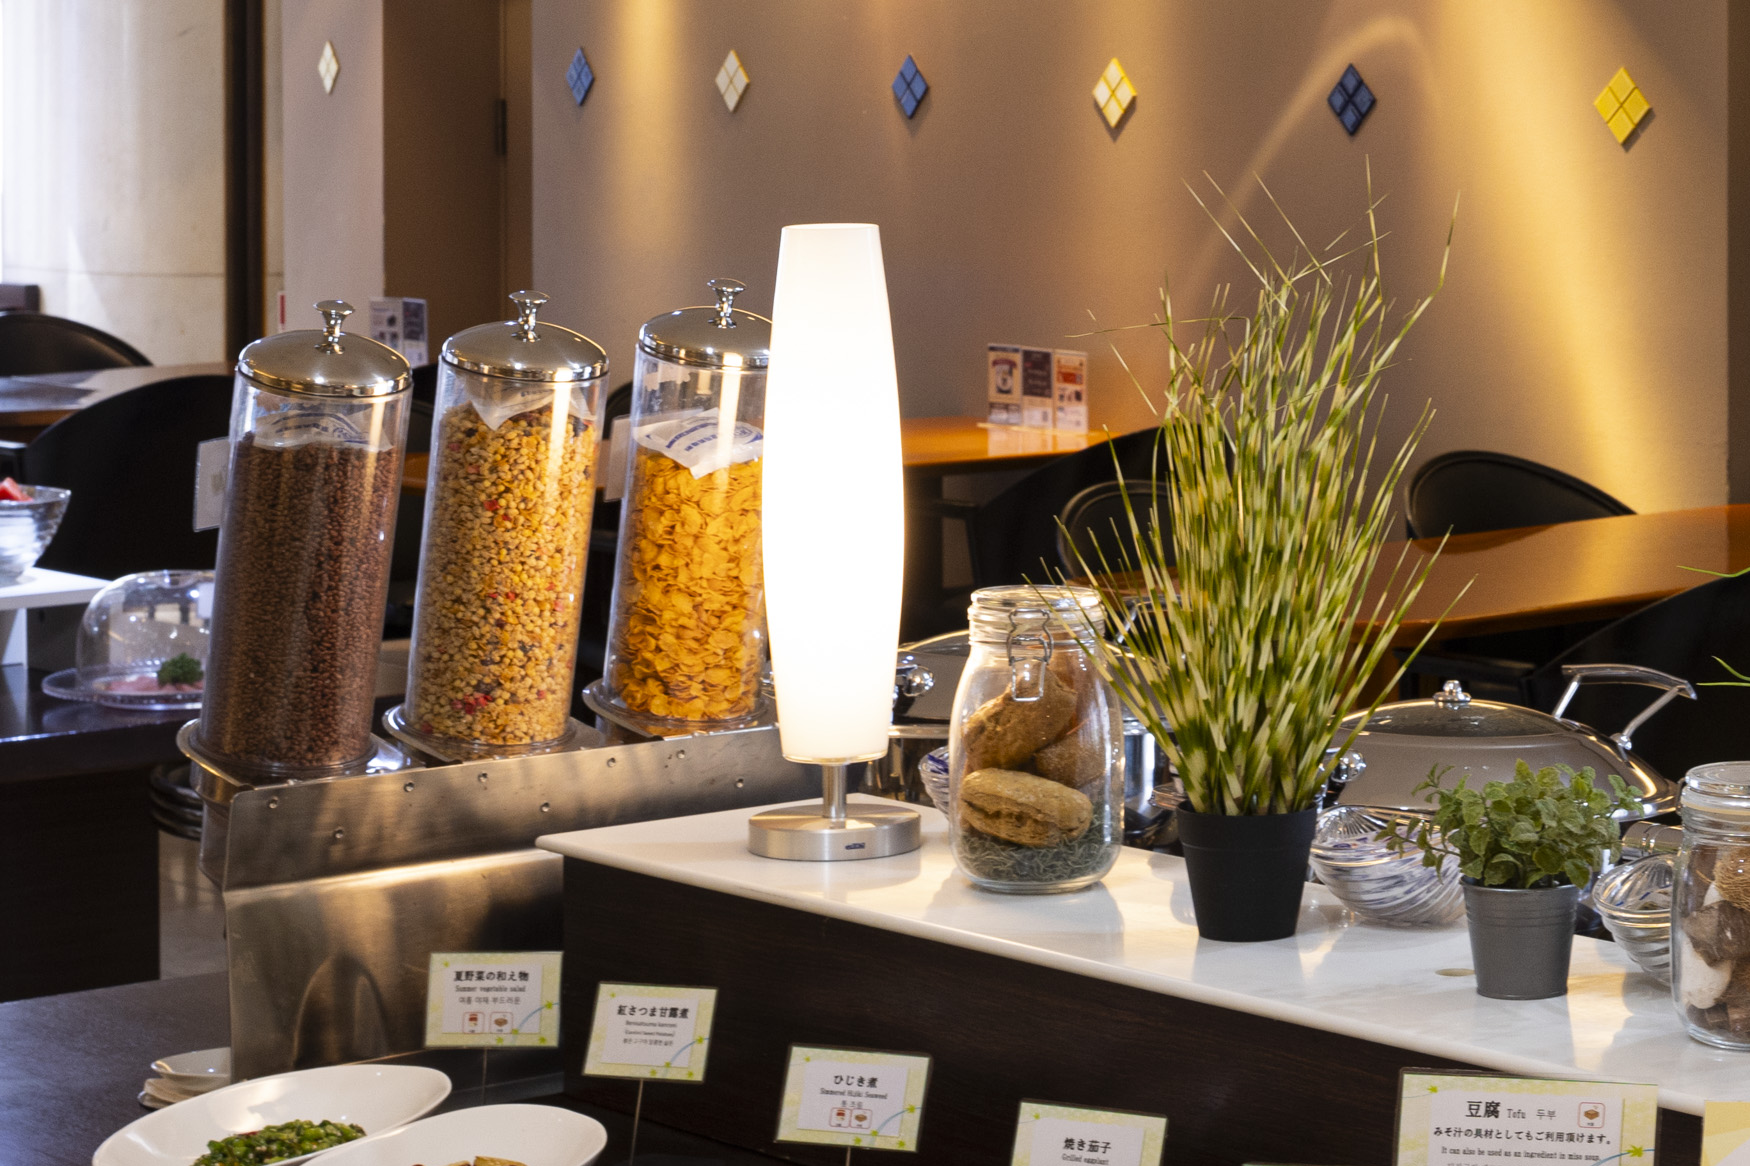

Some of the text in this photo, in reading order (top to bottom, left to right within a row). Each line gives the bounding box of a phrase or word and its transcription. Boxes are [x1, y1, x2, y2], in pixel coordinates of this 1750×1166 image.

[454, 971, 529, 981] 夏野菜の和え物
[617, 1005, 689, 1019] 紅さつま甘露煮
[833, 1074, 878, 1088] ひじき煮
[1466, 1100, 1557, 1121] 豆腐 Tofu 두부
[1433, 1126, 1612, 1145] みそ汁の具材としてもご利用頂けます。
[1063, 1137, 1111, 1154] 焼き茄子
[1441, 1146, 1448, 1154] It
[1462, 1147, 1475, 1156] also
[1478, 1148, 1485, 1156] be
[1487, 1149, 1502, 1157] used
[1523, 1150, 1558, 1160] ingredient
[1559, 1152, 1566, 1160] in
[1568, 1152, 1583, 1161] miso
